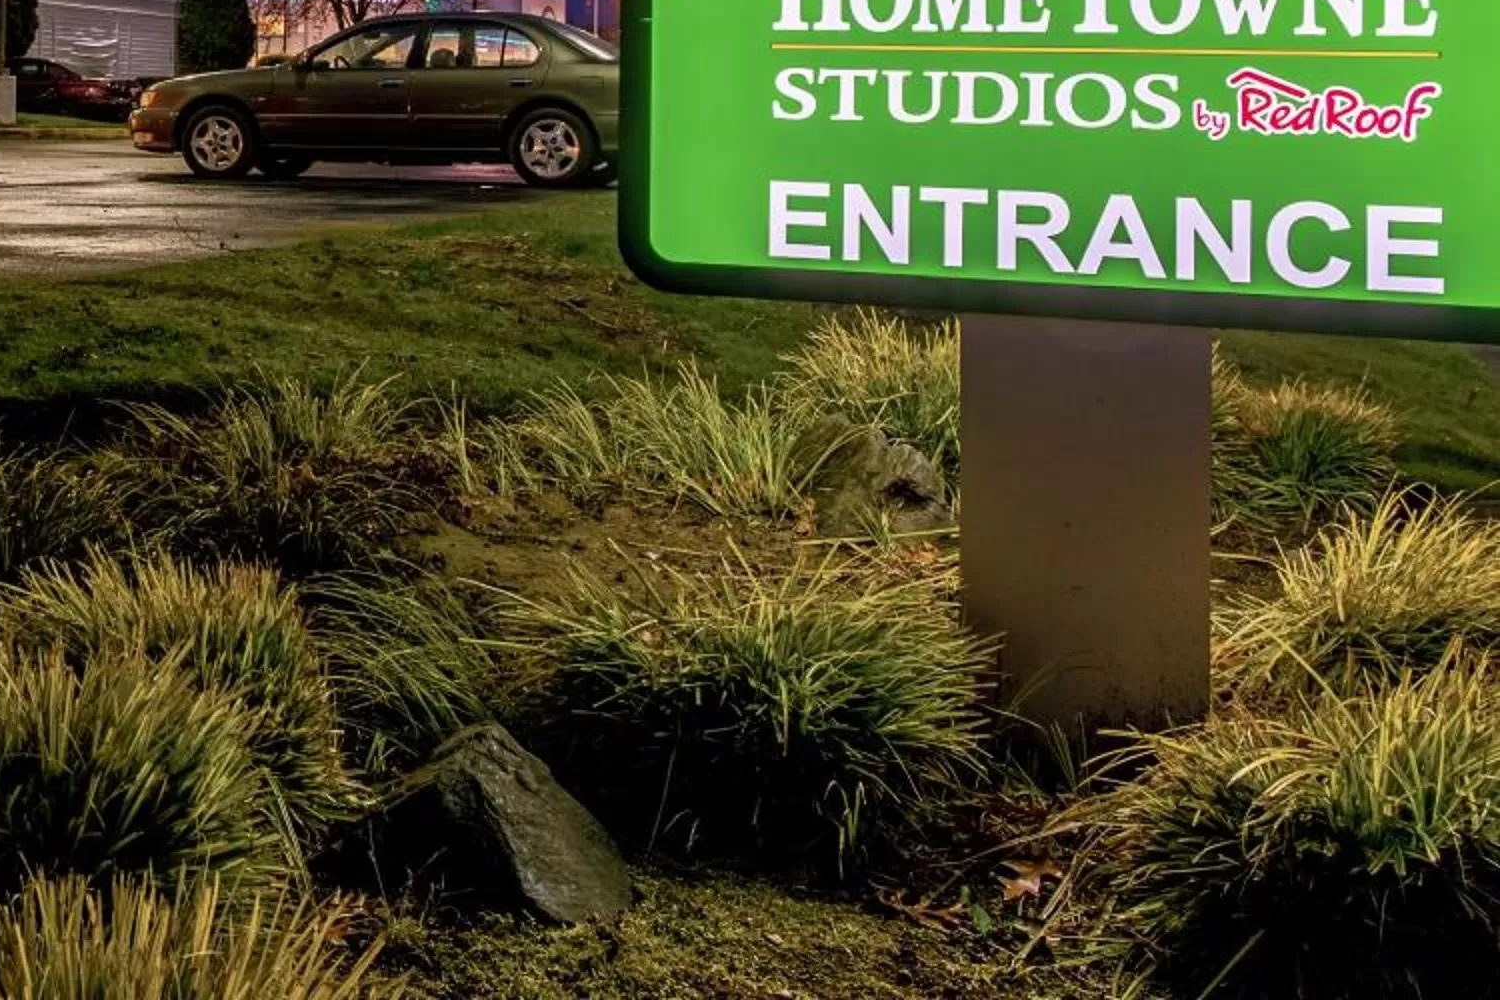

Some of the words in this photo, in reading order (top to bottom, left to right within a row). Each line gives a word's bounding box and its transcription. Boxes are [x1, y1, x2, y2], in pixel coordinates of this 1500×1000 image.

[771, 67, 1182, 130] STUDIOS
[1193, 99, 1231, 141] by
[767, 179, 1446, 295] ENTRANCE
